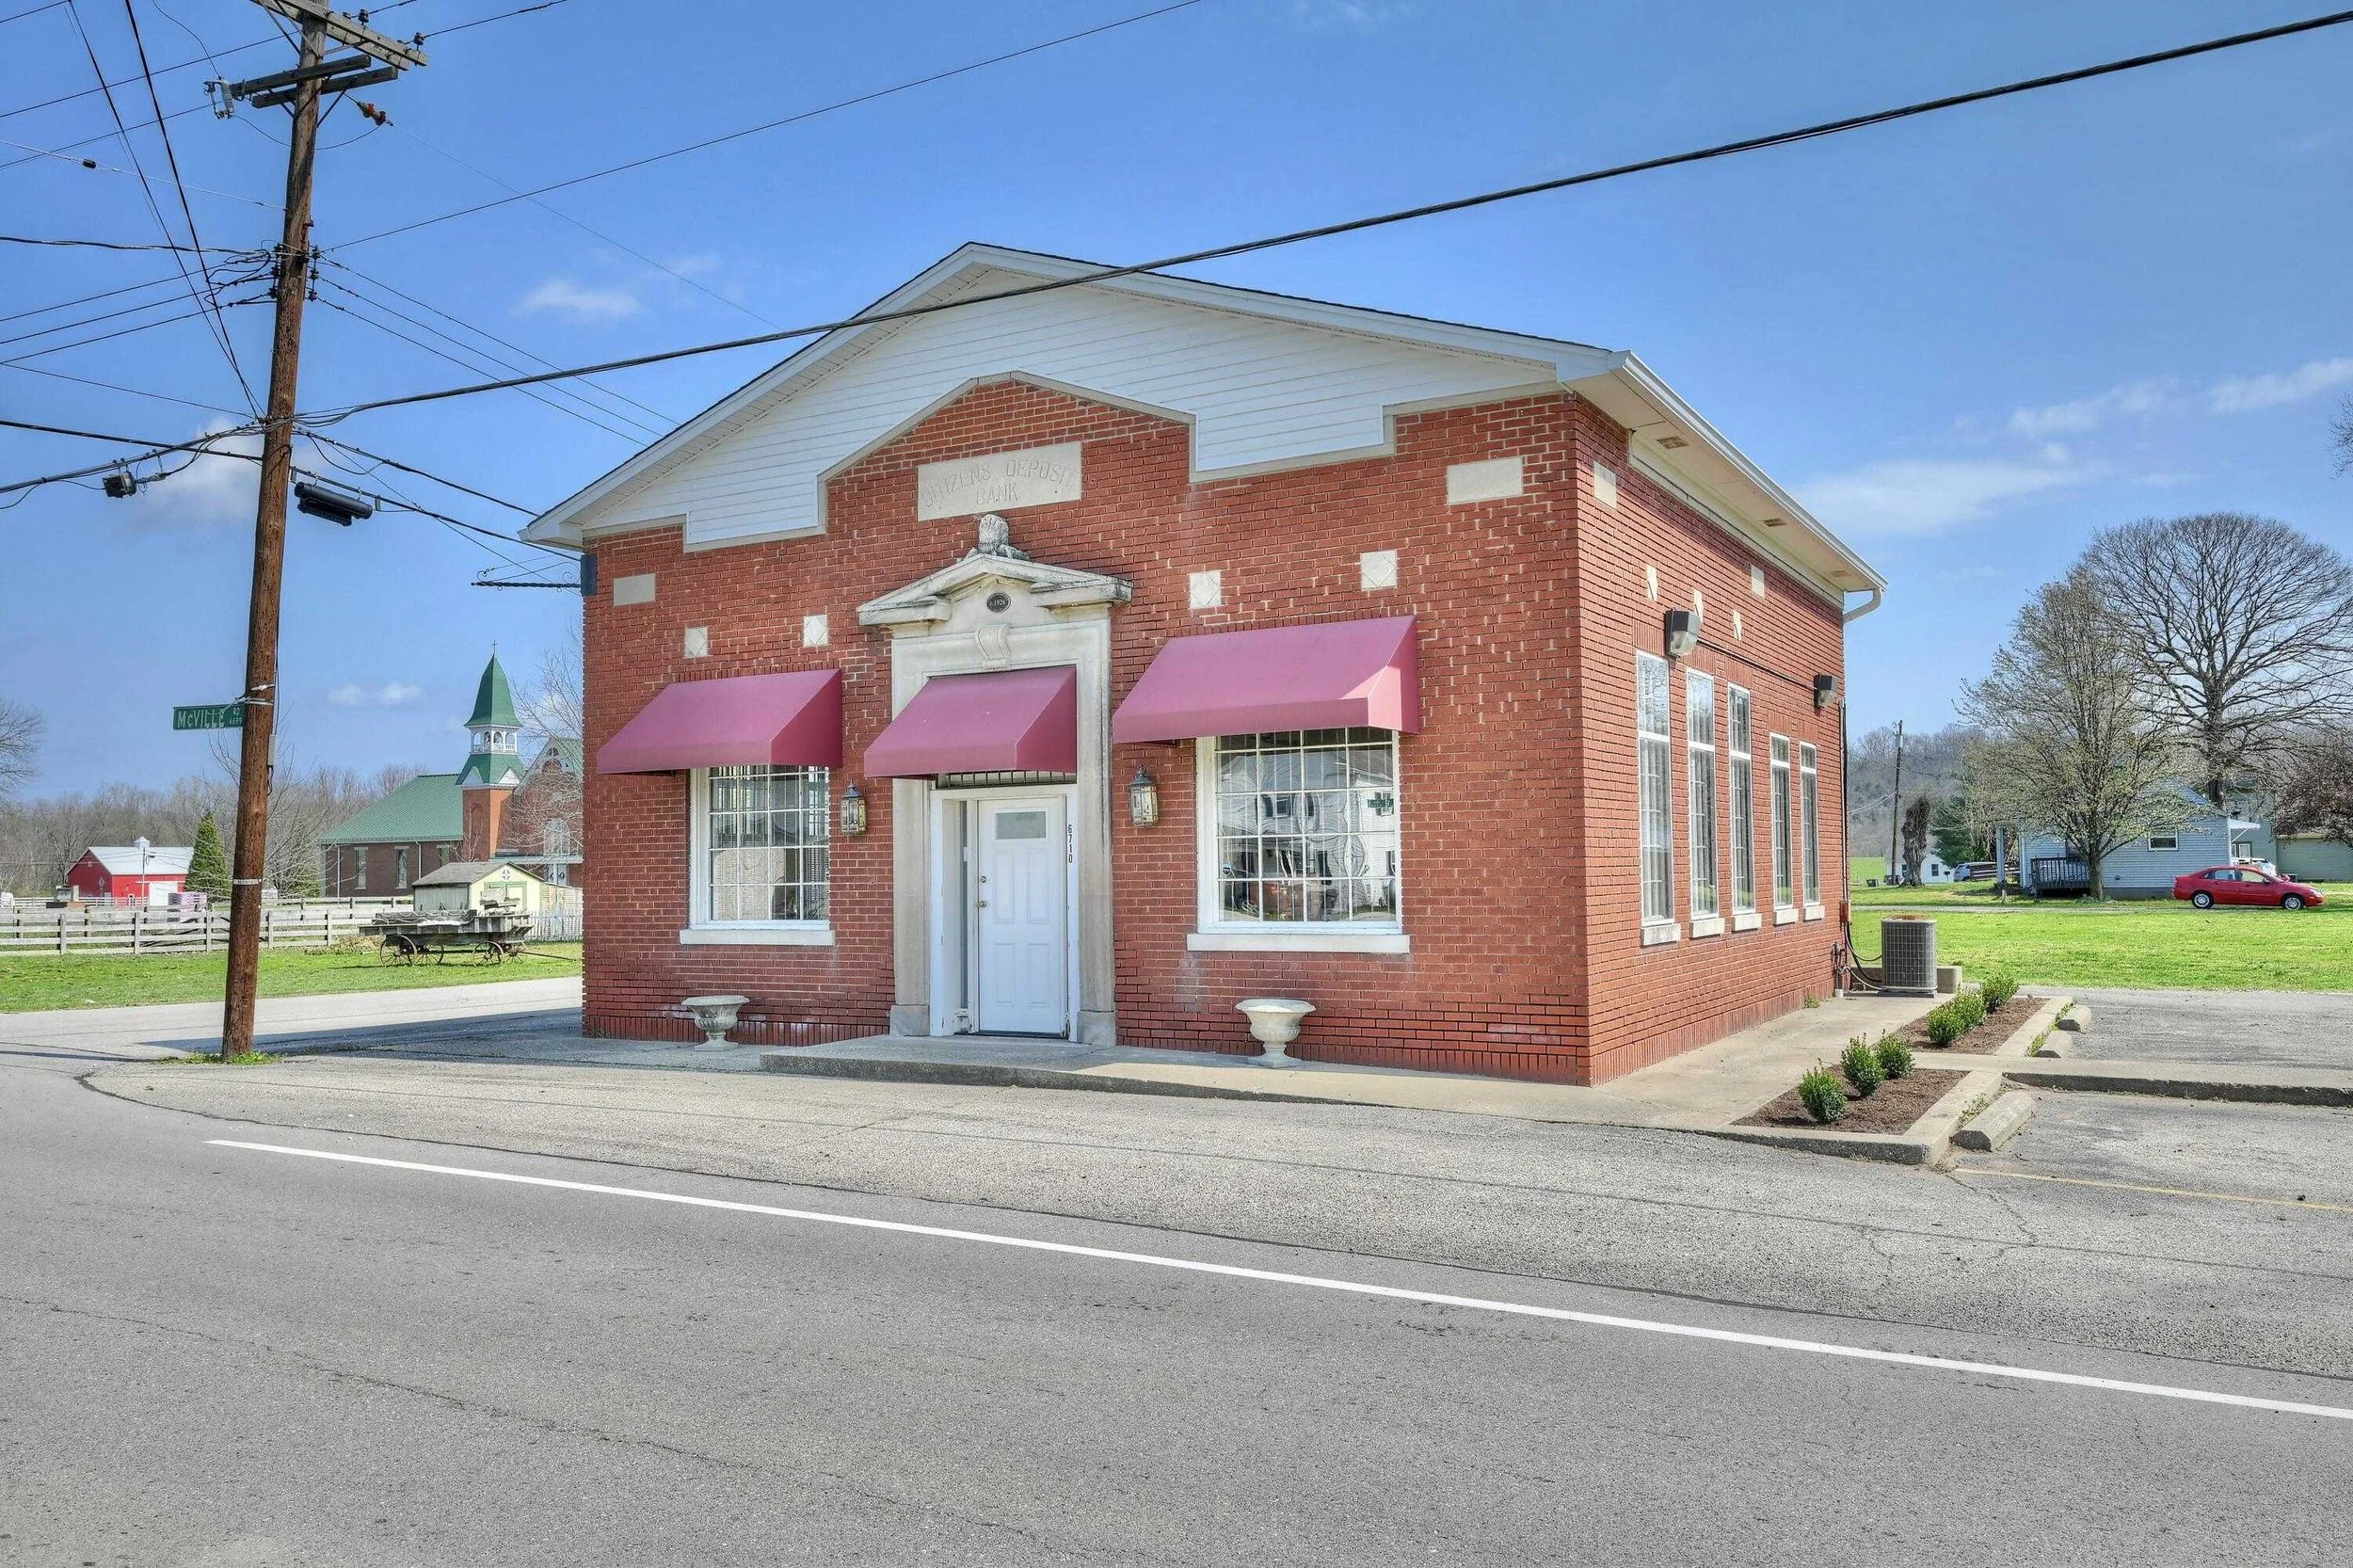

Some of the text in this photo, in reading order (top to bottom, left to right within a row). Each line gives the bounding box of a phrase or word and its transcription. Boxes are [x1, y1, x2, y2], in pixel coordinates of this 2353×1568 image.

[922, 458, 1074, 507] CITIZENS DEPOSIT
[976, 482, 1018, 505] BANK
